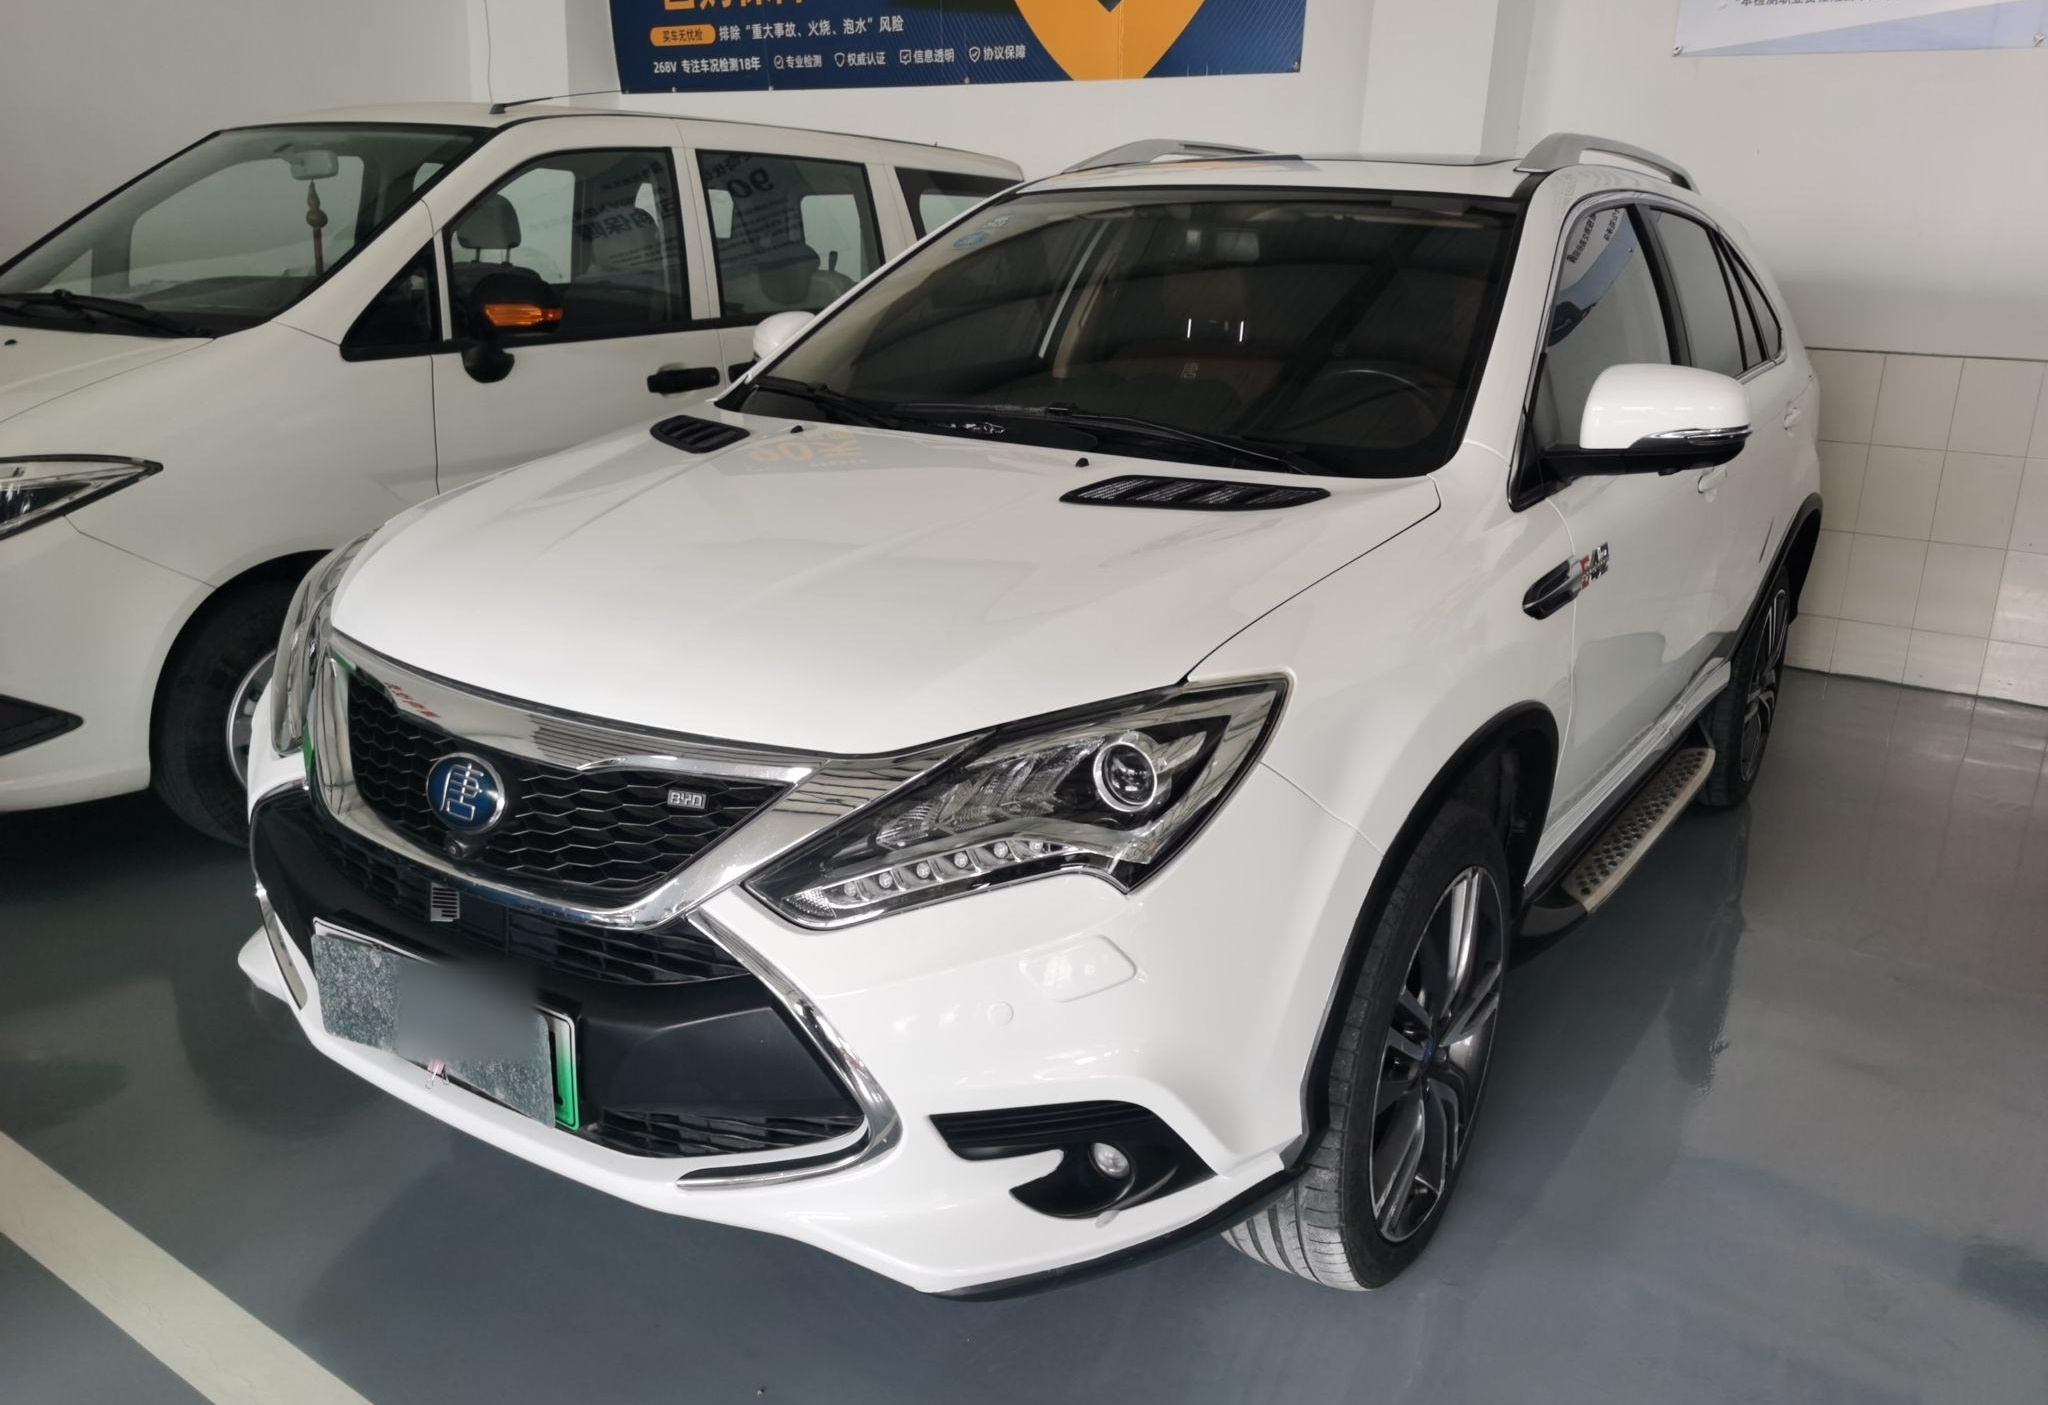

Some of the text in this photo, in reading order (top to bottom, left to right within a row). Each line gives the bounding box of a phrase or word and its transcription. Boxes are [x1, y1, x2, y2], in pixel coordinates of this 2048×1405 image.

[847, 52, 886, 67] 权威认证
[913, 49, 955, 64] 信息透明
[983, 45, 1026, 61] 协议保障
[653, 56, 761, 73] 268V 专注车况检测18年
[786, 54, 822, 69] 专业检测
[669, 791, 703, 807] BYD
